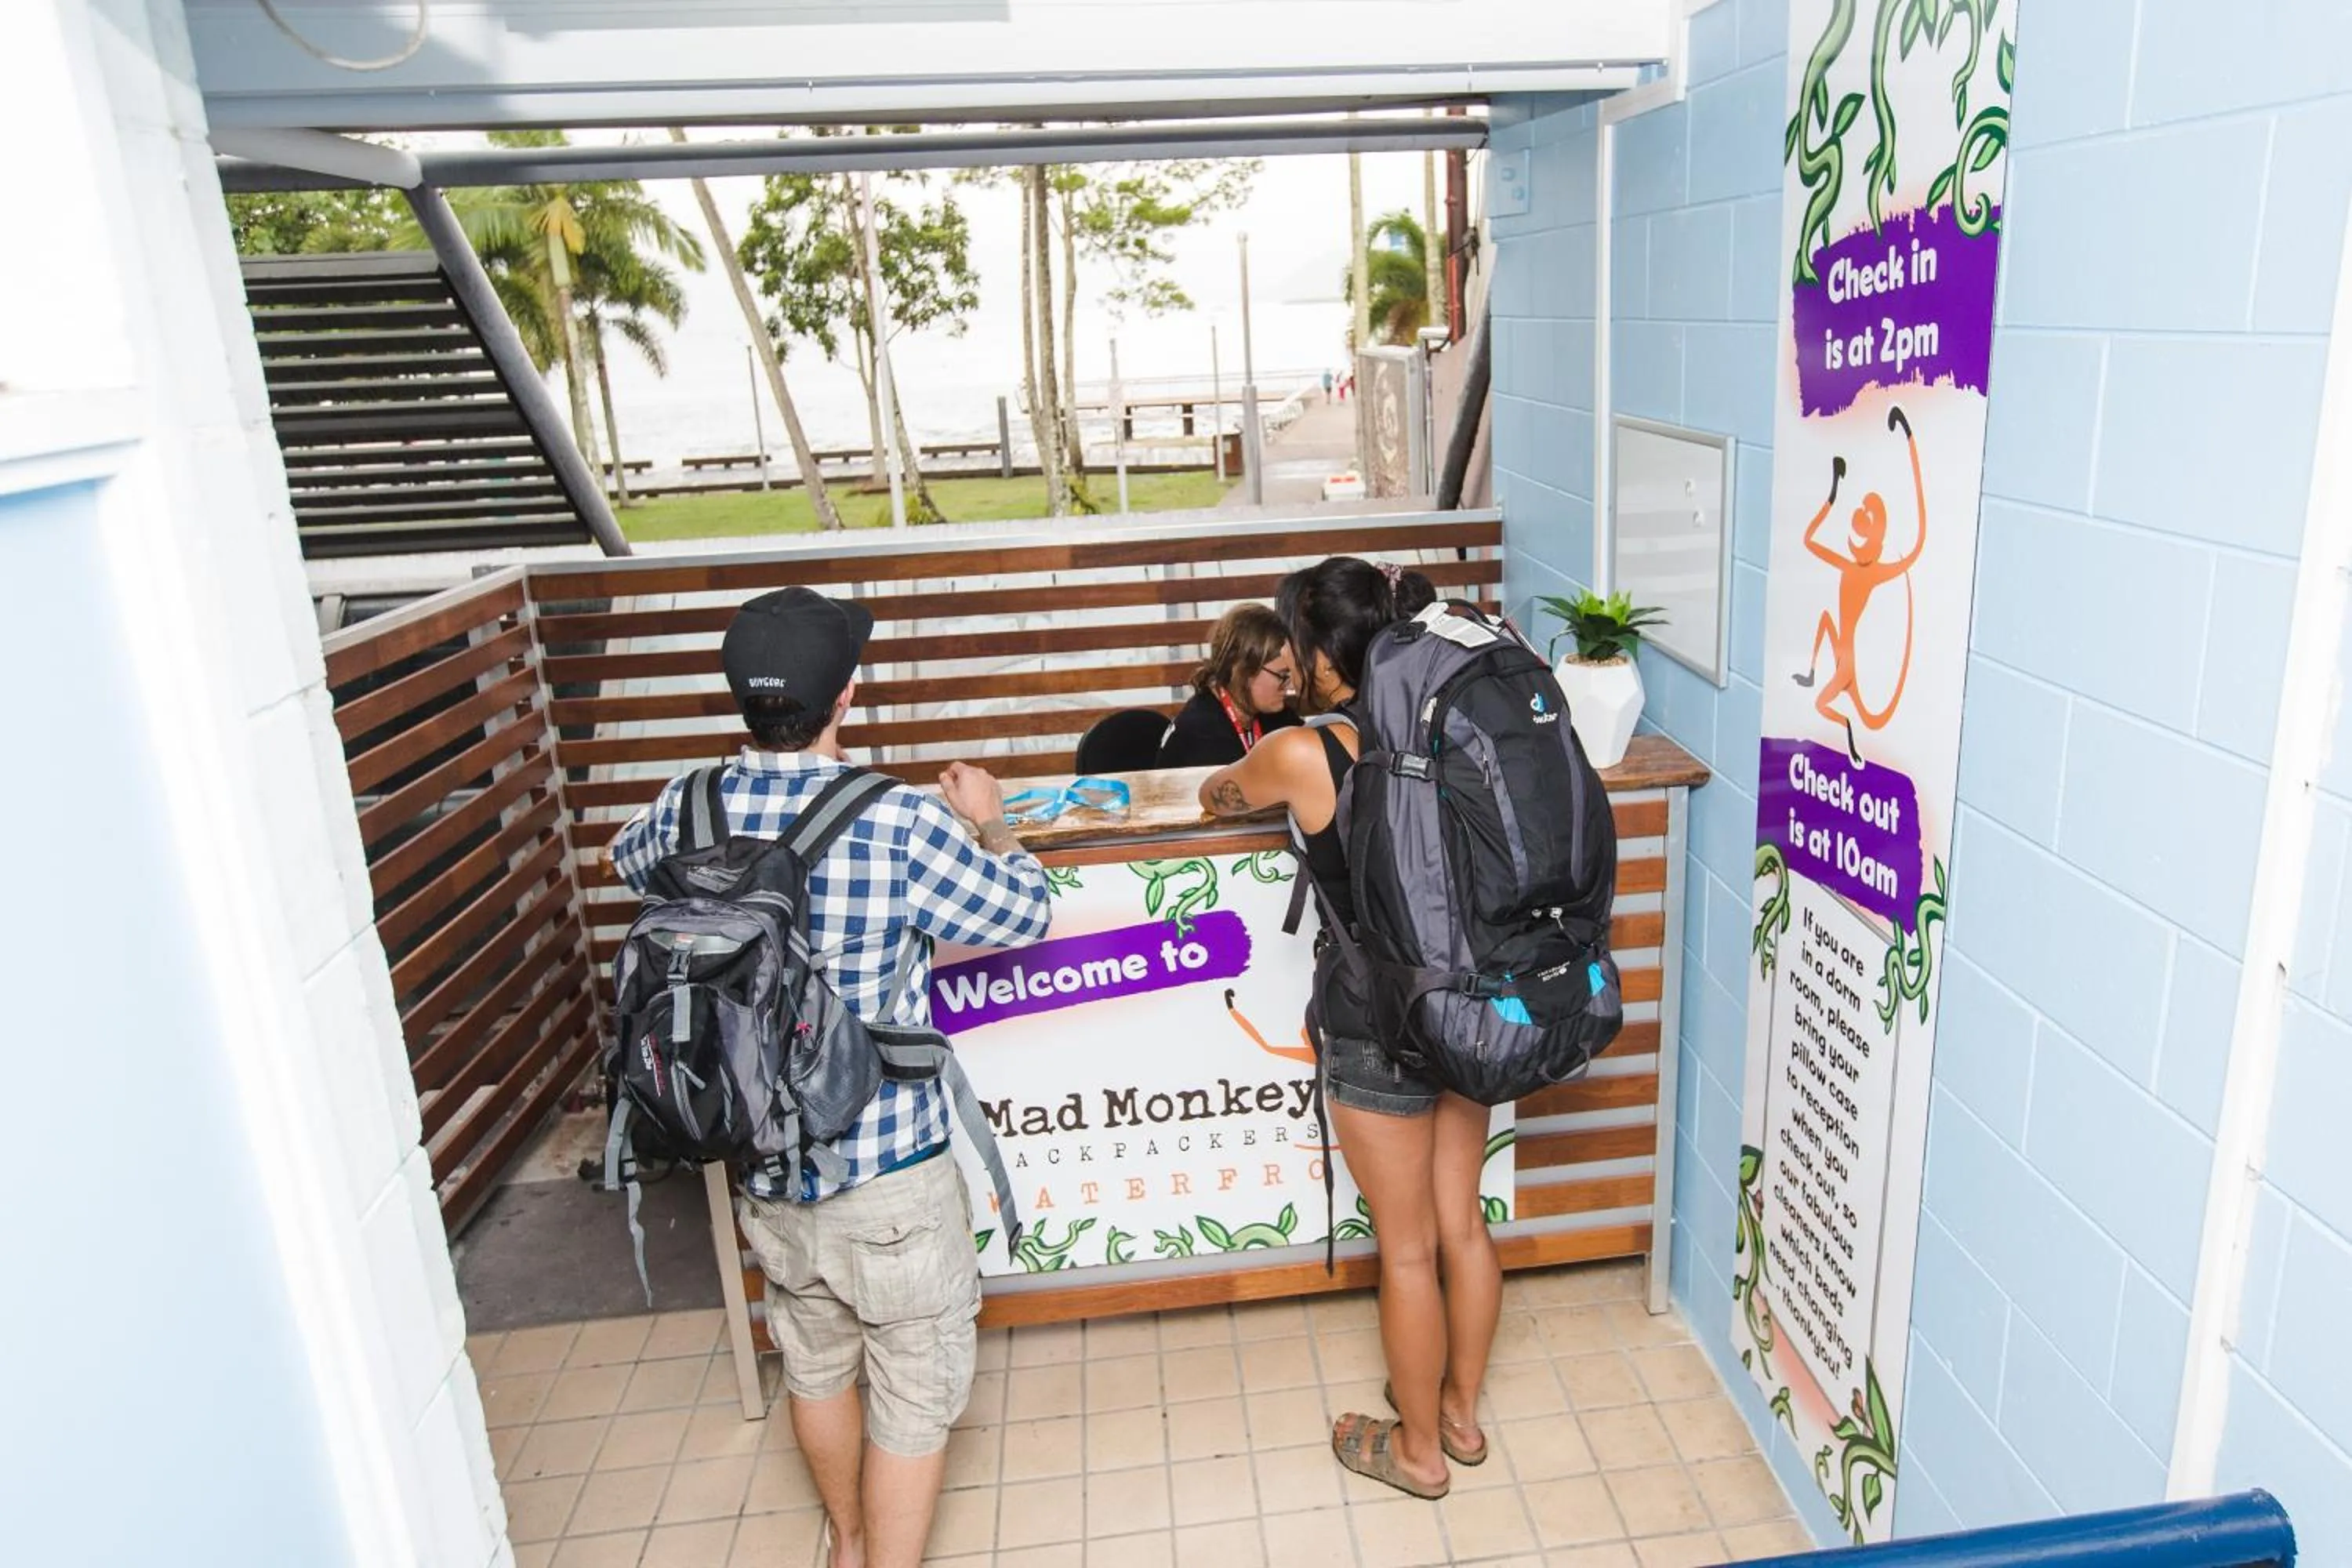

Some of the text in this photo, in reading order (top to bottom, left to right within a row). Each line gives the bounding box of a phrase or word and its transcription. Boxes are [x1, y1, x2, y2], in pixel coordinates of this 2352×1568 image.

[1828, 238, 1936, 304] Check in
[1825, 318, 1939, 373] is at 2pm
[1789, 753, 1900, 834] Check out
[1788, 808, 1898, 899] is at 10am
[937, 938, 1209, 1014] Welcome to
[1802, 940, 1861, 1013] in a dorm
[1803, 906, 1864, 978] If you are
[1790, 971, 1870, 1059] room, please
[1795, 1004, 1860, 1084] bring your
[978, 1078, 1317, 1138] Mad Monkey
[1786, 1065, 1860, 1160] to reception
[1791, 1040, 1859, 1122] pillow case
[984, 1122, 1319, 1169] ACKPACKERS
[1780, 1129, 1857, 1229] check out, so
[1791, 1108, 1848, 1184] when you
[987, 1159, 1325, 1214] WATERFRO
[1779, 1160, 1854, 1261] our fabulous
[1773, 1185, 1857, 1299] cleaners know
[1780, 1223, 1844, 1318] which beds
[1769, 1240, 1853, 1370] need changing
